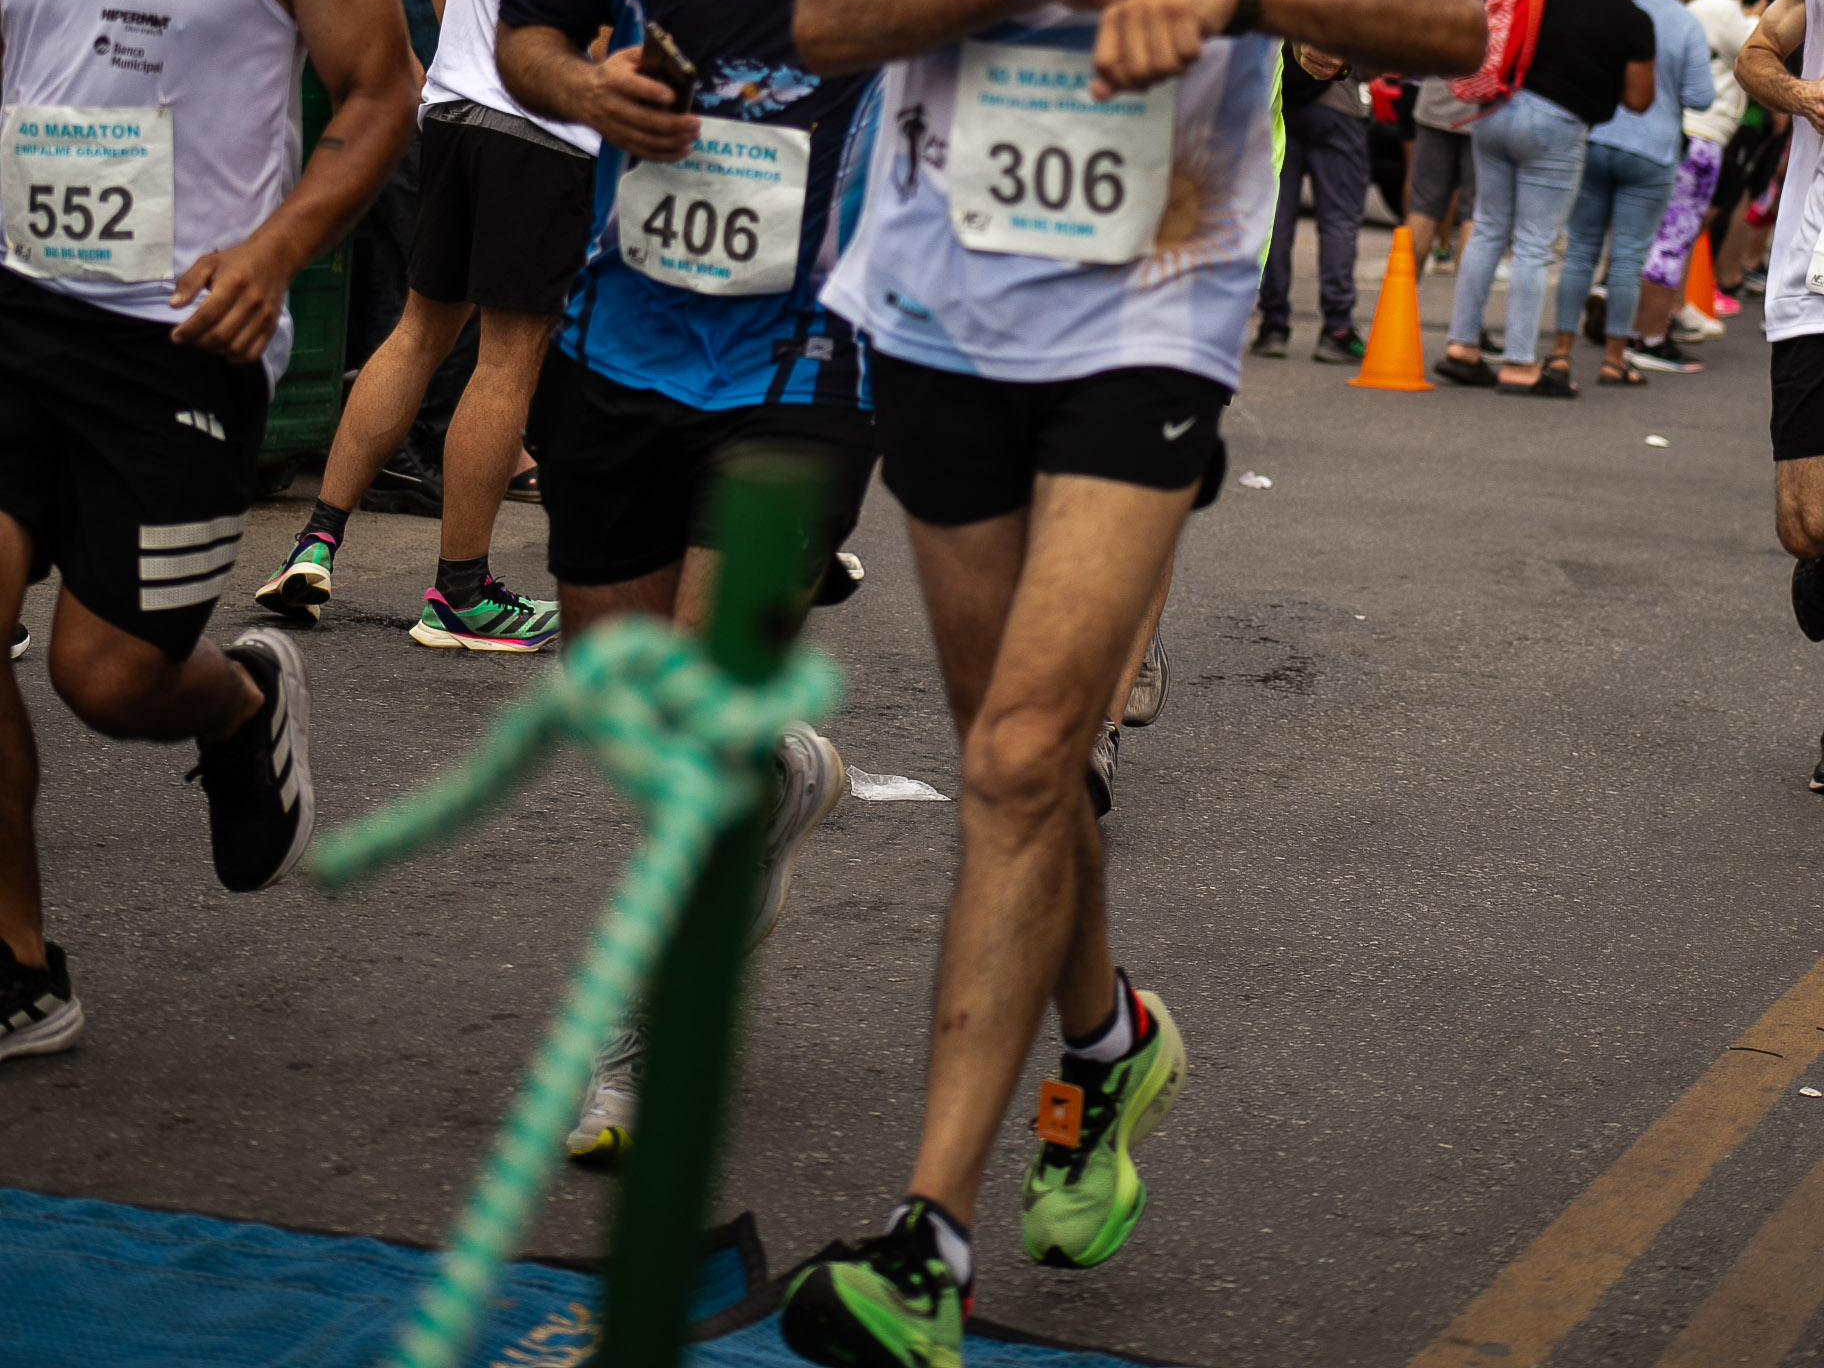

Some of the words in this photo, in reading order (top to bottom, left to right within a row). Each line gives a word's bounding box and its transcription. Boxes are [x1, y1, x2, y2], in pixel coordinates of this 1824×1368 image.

[113, 42, 145, 57] Banco
[111, 56, 165, 75] Municipal
[18, 123, 39, 137] 40
[43, 123, 141, 140] MARATON
[693, 139, 778, 163] ARATON
[987, 143, 1126, 216] 306
[28, 184, 135, 242] 552
[642, 192, 760, 264] 406
